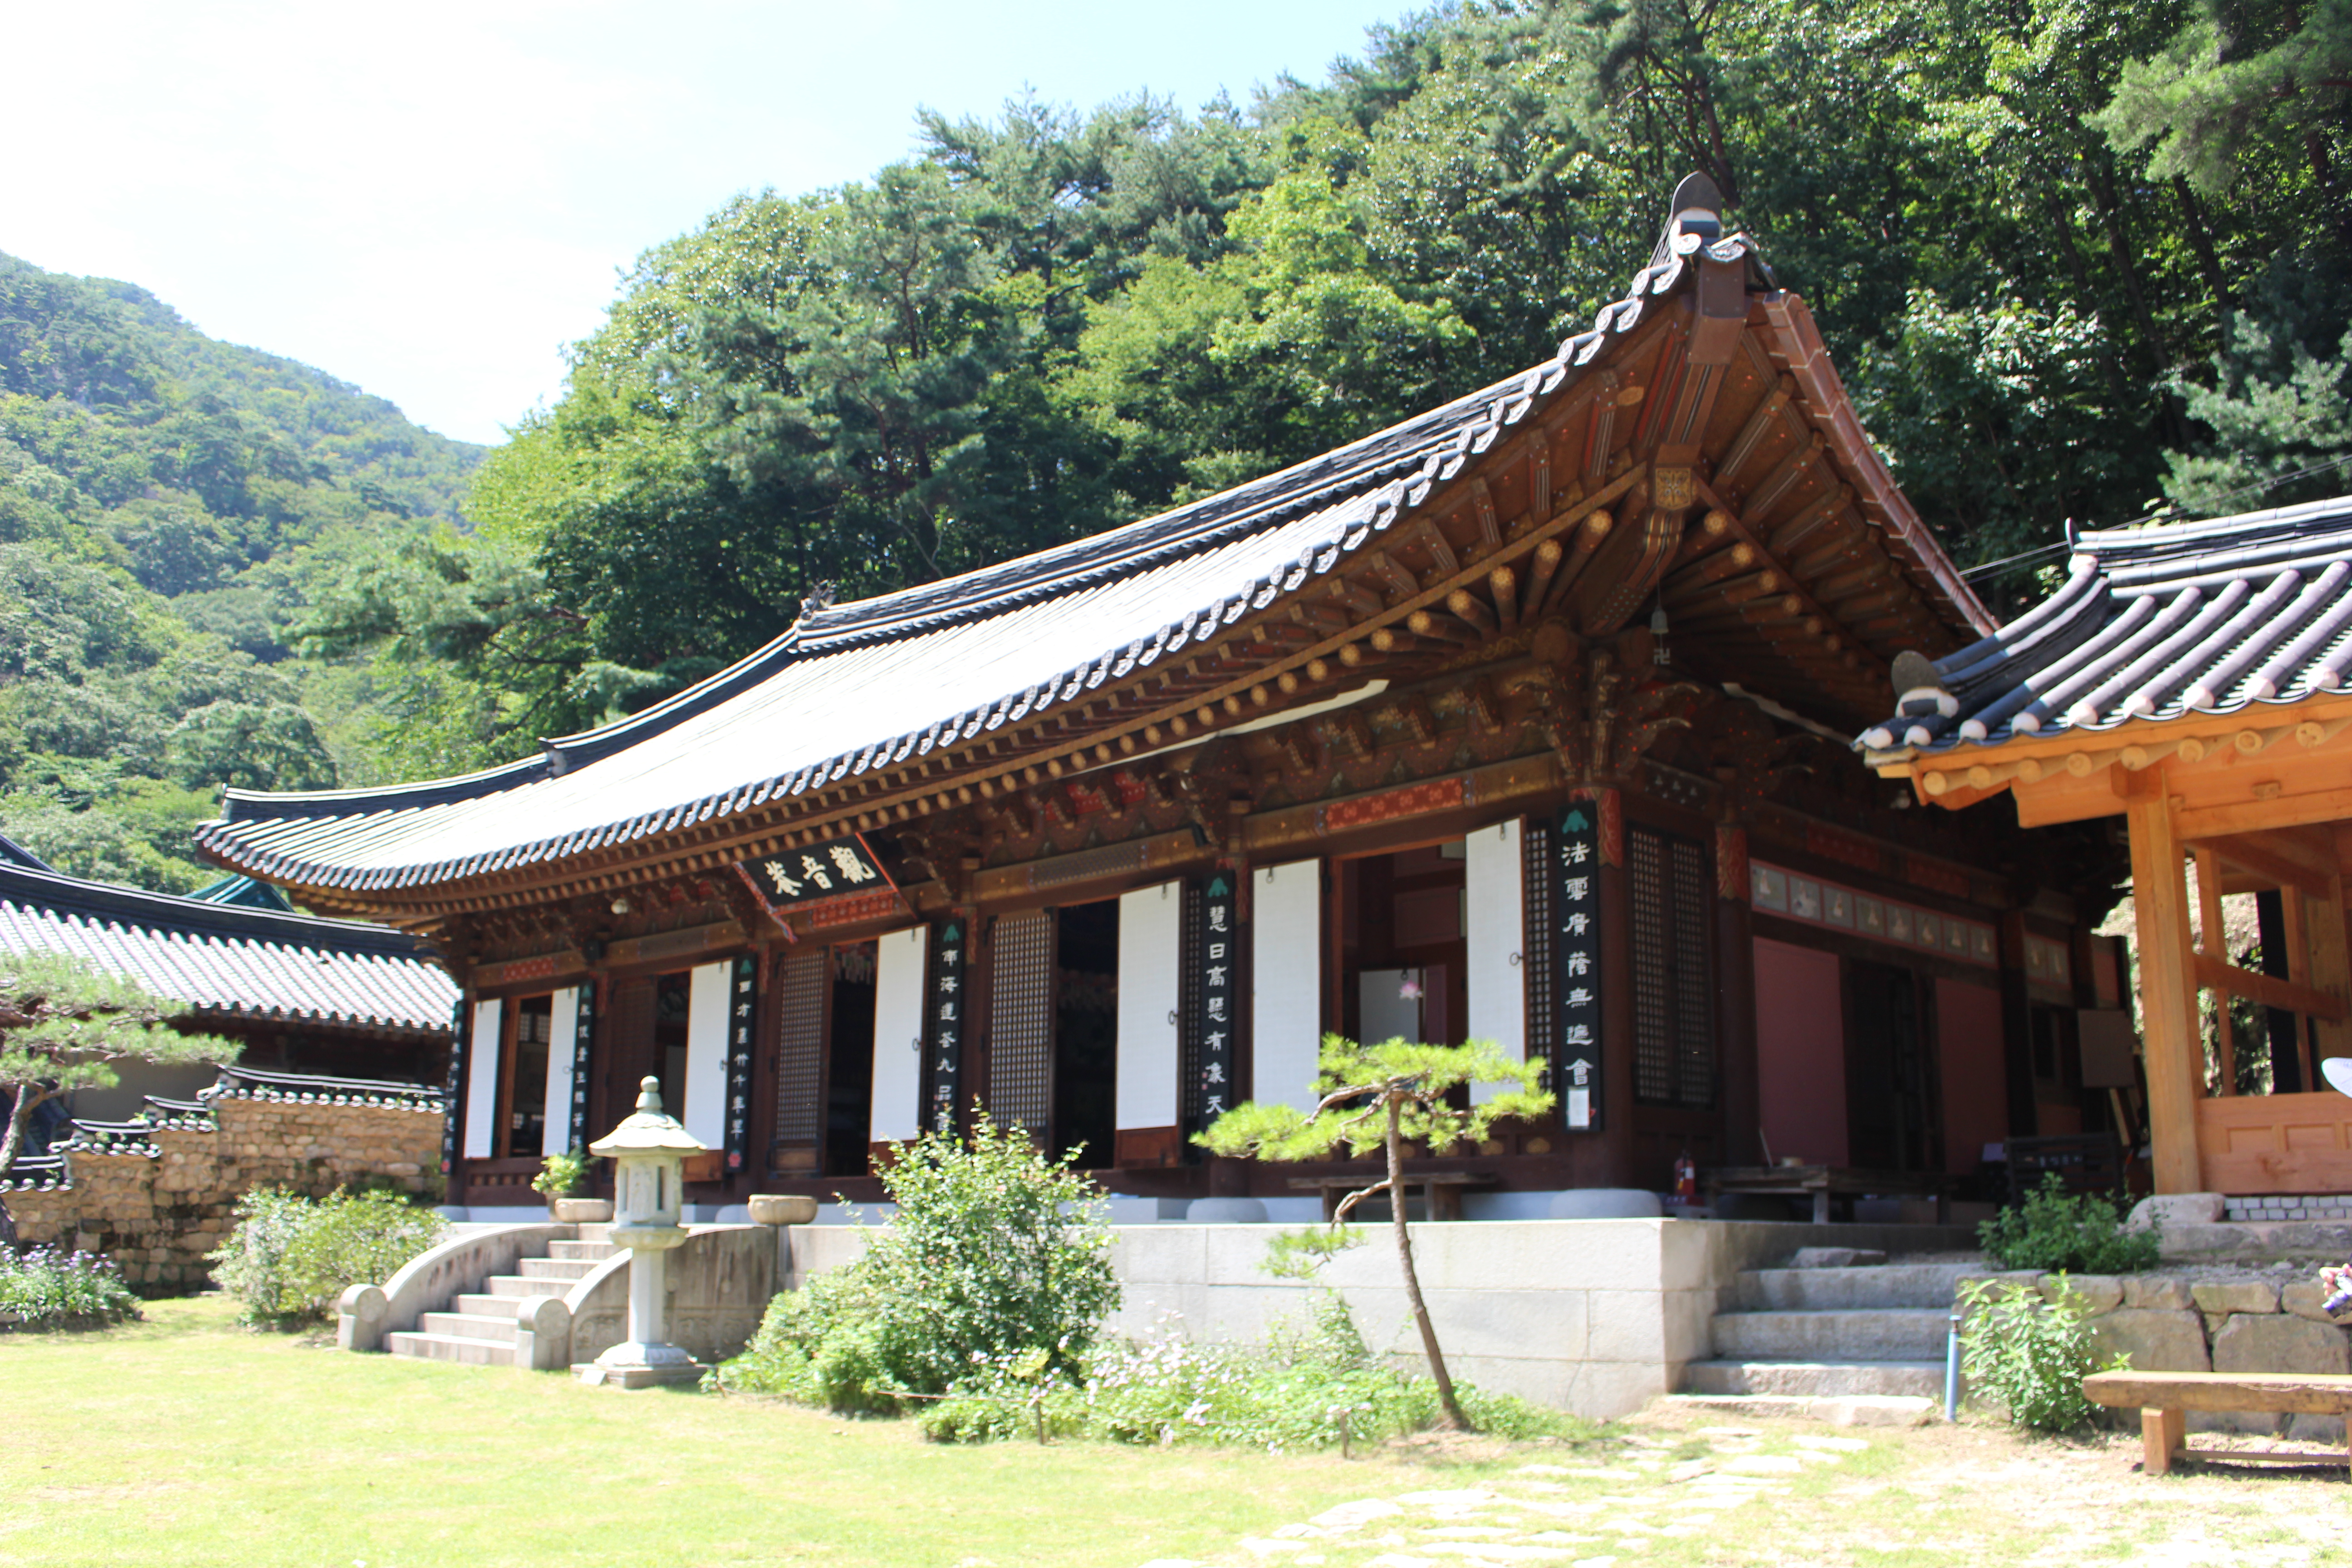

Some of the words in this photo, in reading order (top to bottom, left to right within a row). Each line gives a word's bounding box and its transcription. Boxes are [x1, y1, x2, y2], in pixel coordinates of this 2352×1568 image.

[1205, 906, 1228, 1114] 慧日高懸有象天
[1563, 840, 1593, 1085] 法雲廣蔭無遮會
